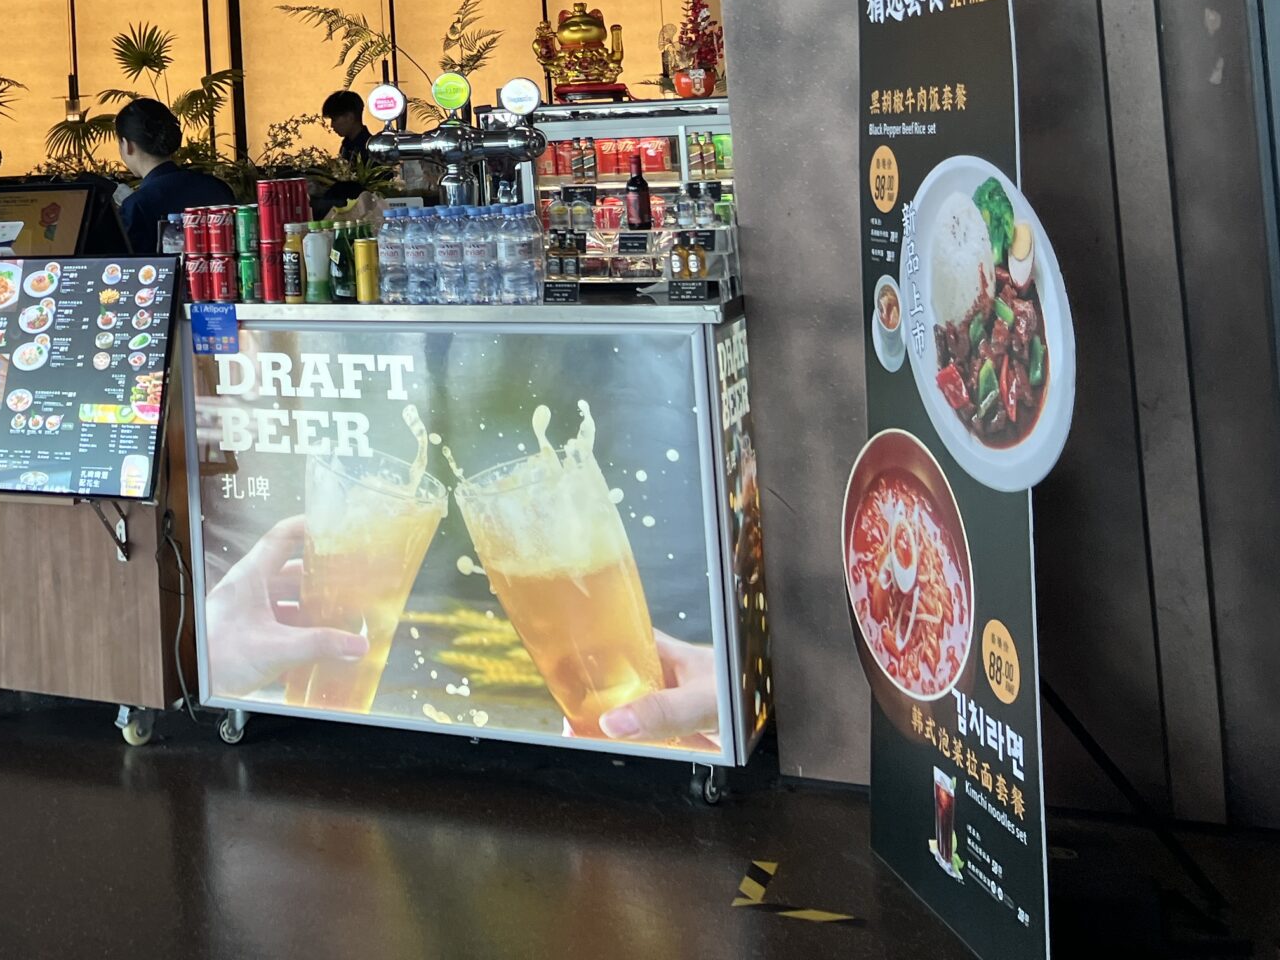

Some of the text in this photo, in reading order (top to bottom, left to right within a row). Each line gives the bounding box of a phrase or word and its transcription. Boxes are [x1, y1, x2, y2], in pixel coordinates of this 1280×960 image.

[869, 83, 968, 115] 黑胡椒牛肉饭套餐
[869, 122, 936, 138] Black Pepper Beef Rice set
[901, 200, 926, 359] 新品上市
[214, 352, 414, 401] DRAFT
[721, 377, 750, 431] BEER
[218, 408, 373, 458] BEER
[221, 474, 271, 501] 扎啤
[988, 651, 1015, 687] 88.00
[951, 688, 1025, 782] 김치라면
[911, 704, 1026, 821] 韩式泡菜拉面套餐
[964, 780, 987, 812] Kimchi
[987, 799, 1015, 836] noodles
[1015, 826, 1028, 846] set
